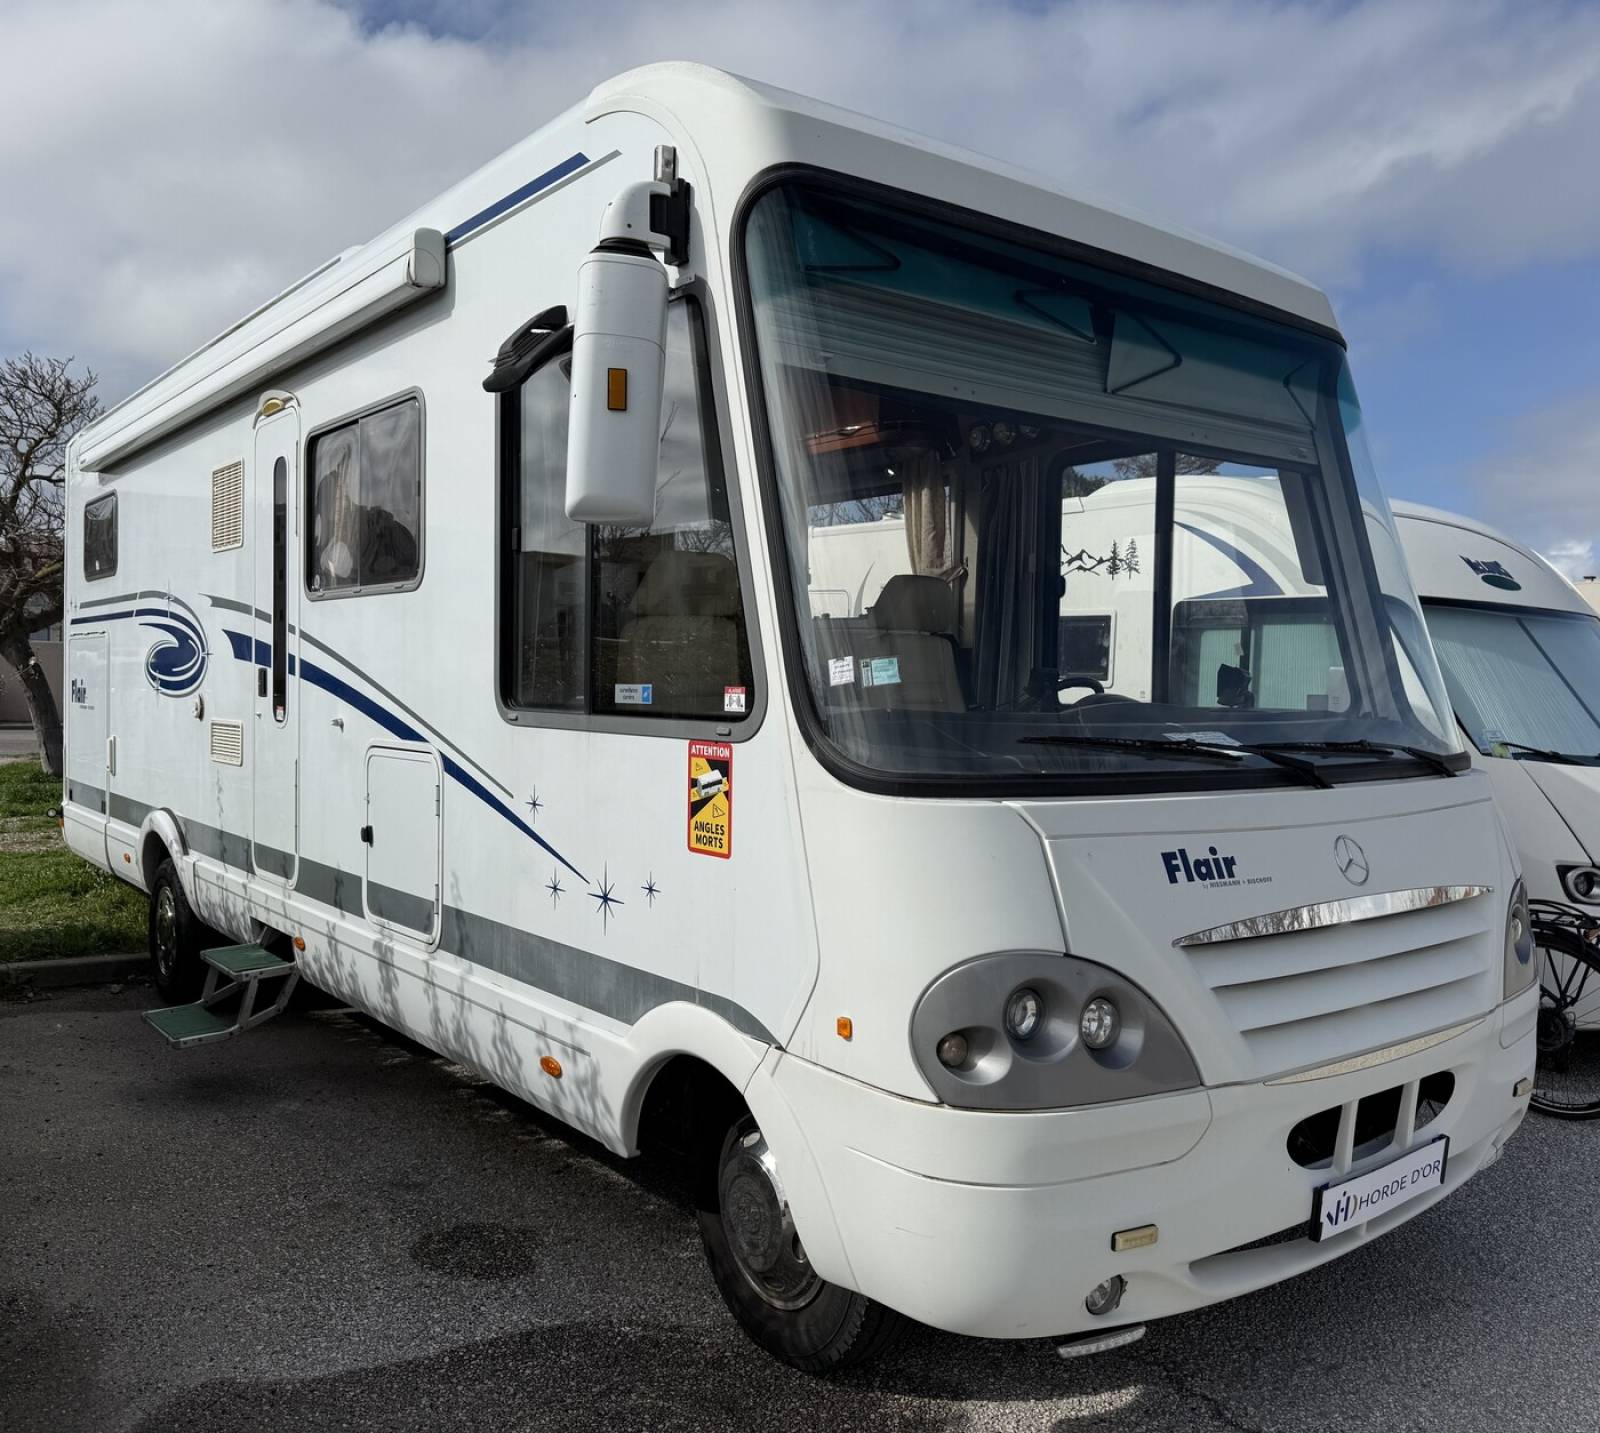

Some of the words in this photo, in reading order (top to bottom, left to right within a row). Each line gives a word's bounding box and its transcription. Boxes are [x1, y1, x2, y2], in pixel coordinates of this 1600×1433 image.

[691, 745, 730, 758] ATTENTION
[694, 821, 725, 836] ANGLES
[695, 834, 723, 849] MORTS
[1161, 846, 1237, 884] Flair
[1359, 1175, 1408, 1210] HORDE
[1411, 1160, 1441, 1184] D'OR
